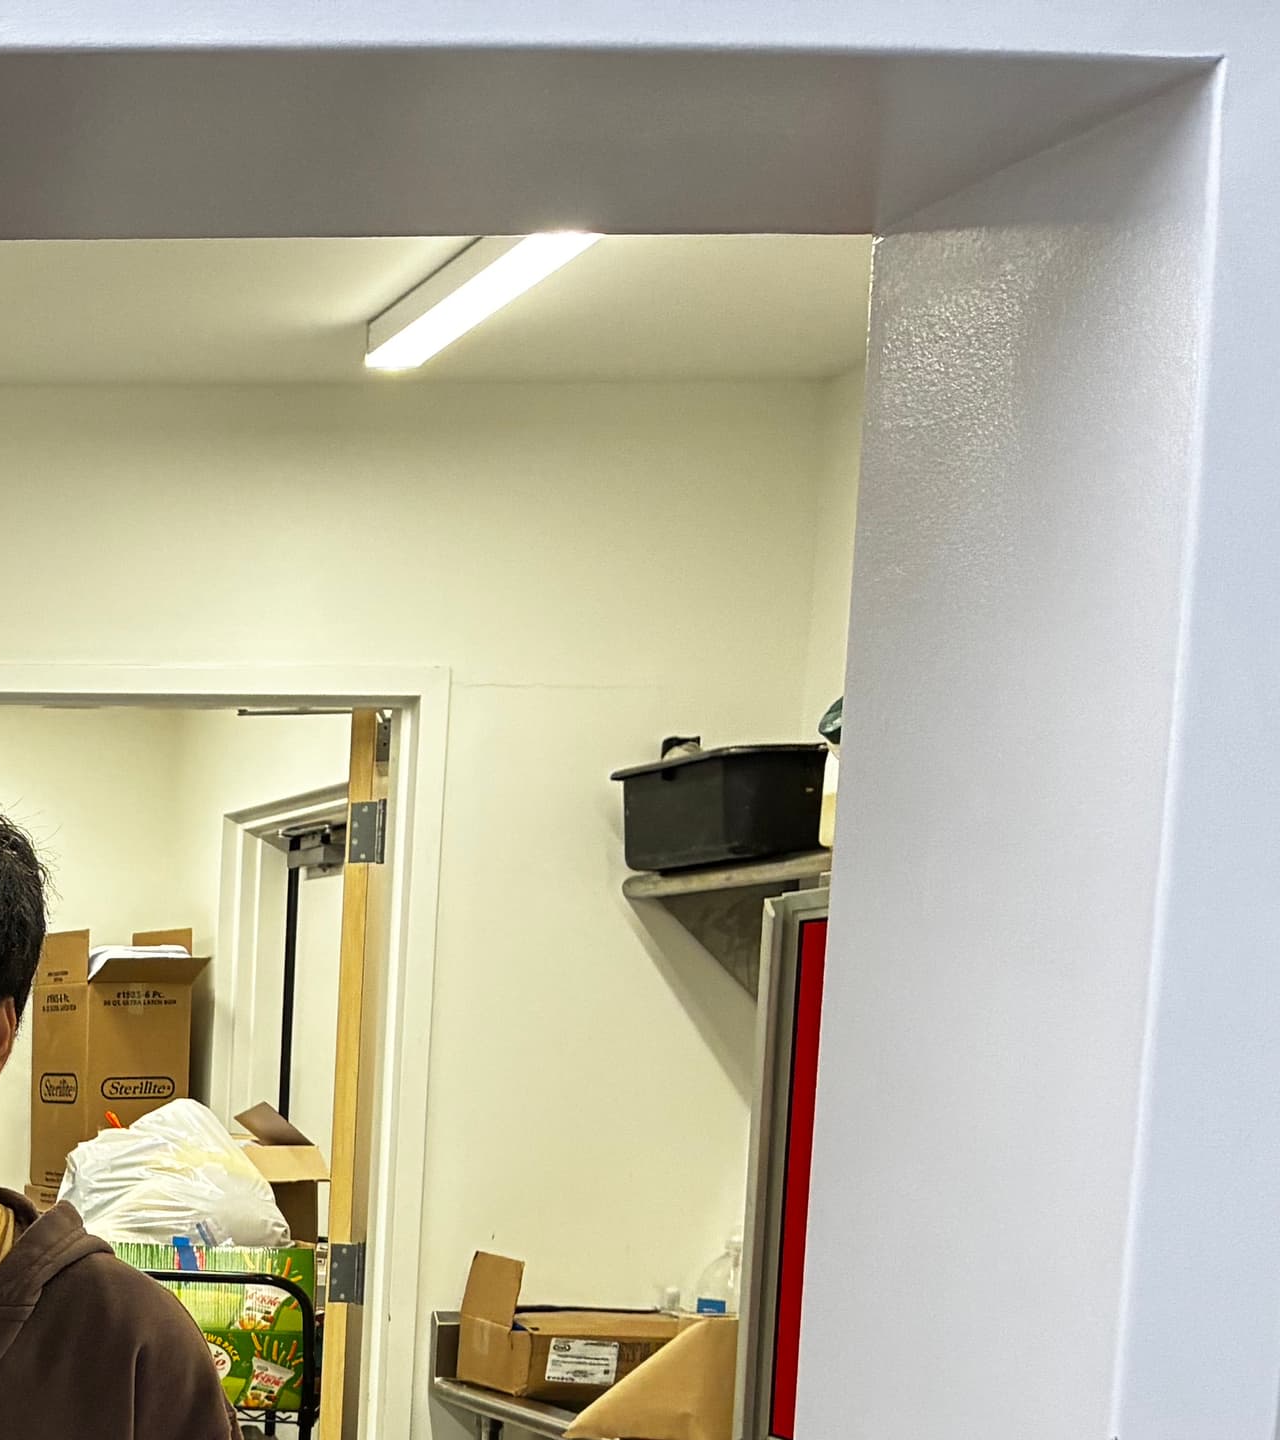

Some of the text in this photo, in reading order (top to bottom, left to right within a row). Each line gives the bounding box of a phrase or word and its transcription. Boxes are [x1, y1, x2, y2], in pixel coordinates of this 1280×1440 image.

[44, 1077, 75, 1098] Sterilite
[109, 1080, 166, 1096] Sterilite
[222, 1341, 241, 1362] PACK
